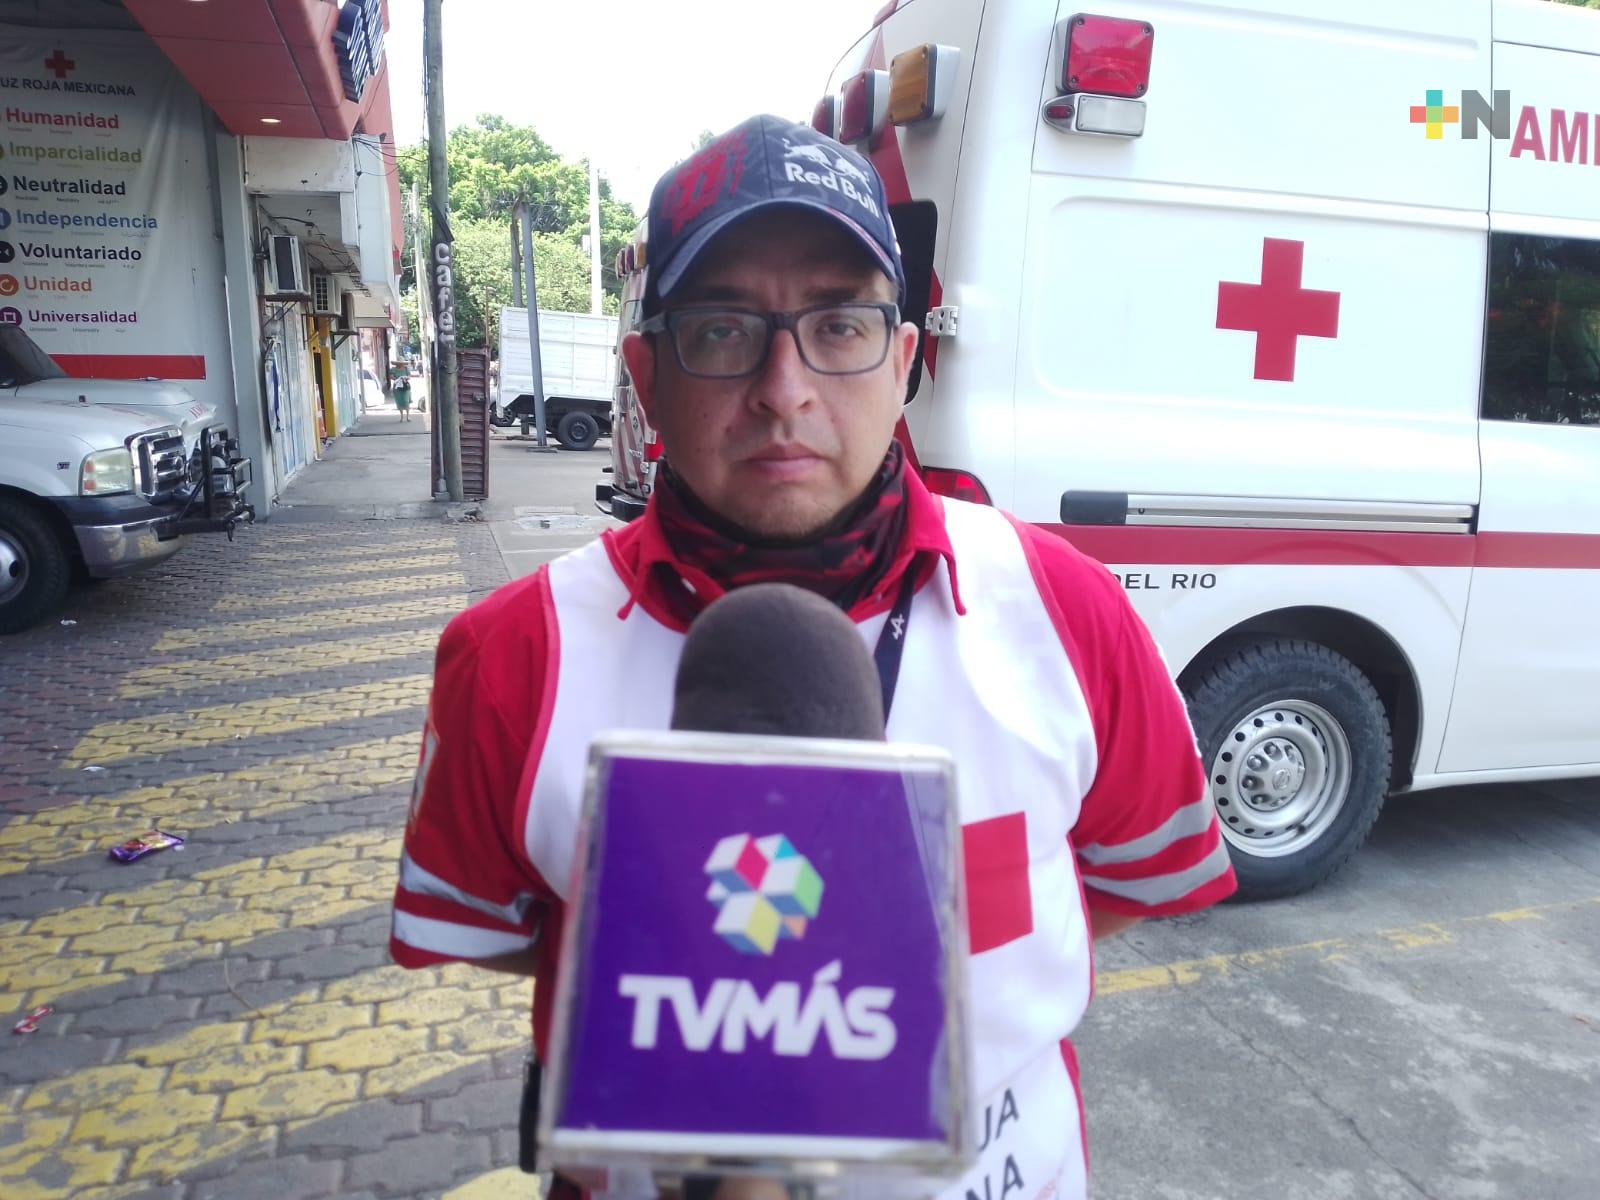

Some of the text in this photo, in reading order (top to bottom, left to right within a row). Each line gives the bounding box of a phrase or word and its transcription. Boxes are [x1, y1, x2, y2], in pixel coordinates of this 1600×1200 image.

[0, 78, 136, 96] UZ ROJA MEXICANA
[6, 107, 119, 129] Humanidad
[1509, 104, 1600, 167] AM
[9, 142, 142, 163] Imparcialidad
[13, 176, 126, 195] Neutralidad
[784, 162, 879, 218] Red Bull
[16, 209, 158, 229] Independencia
[19, 243, 142, 261] Voluntariado
[24, 276, 93, 292] Unidad
[28, 310, 137, 323] Universalidad
[1171, 573, 1217, 589] RIO
[619, 959, 897, 1061] TVMÁS
